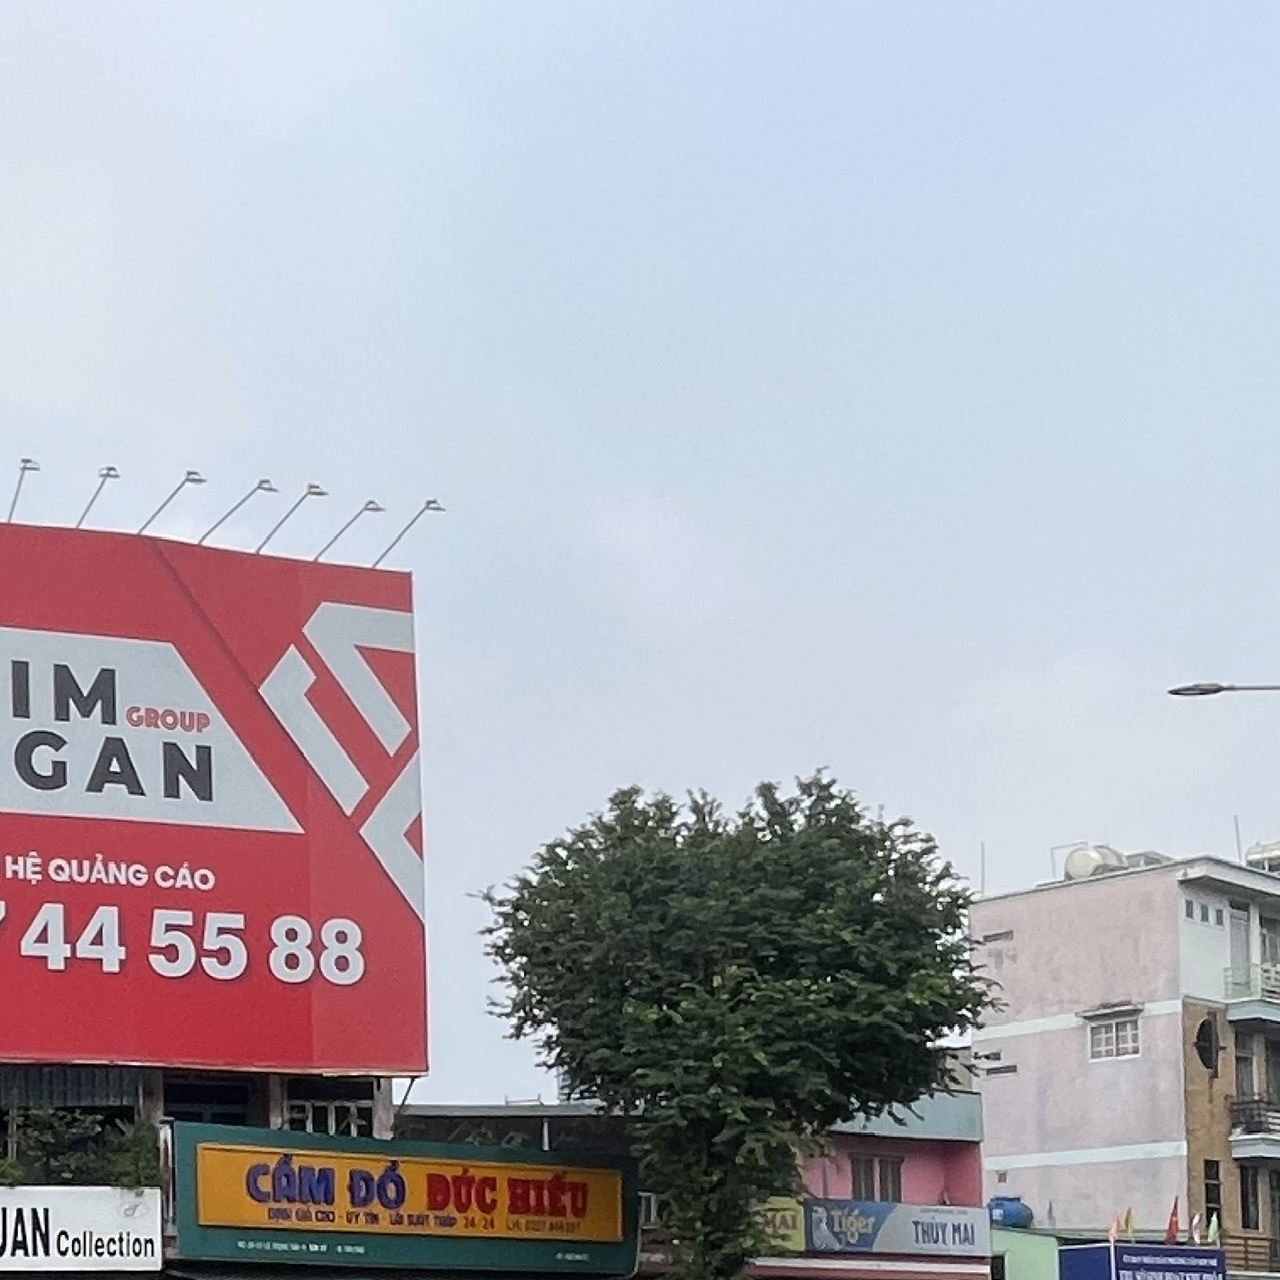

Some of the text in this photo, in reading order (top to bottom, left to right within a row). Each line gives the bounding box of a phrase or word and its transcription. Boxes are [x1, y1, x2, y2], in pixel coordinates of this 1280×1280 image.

[125, 706, 210, 732] GROUP
[5, 851, 42, 885] HỆ
[48, 853, 148, 887] QUẢNG
[154, 862, 216, 890] CÁO
[20, 902, 127, 974] 44
[148, 908, 248, 980] 55
[268, 915, 365, 986] 88
[830, 1206, 875, 1244] Tiger
[951, 1222, 976, 1246] MAI
[57, 1229, 155, 1258] Collection
